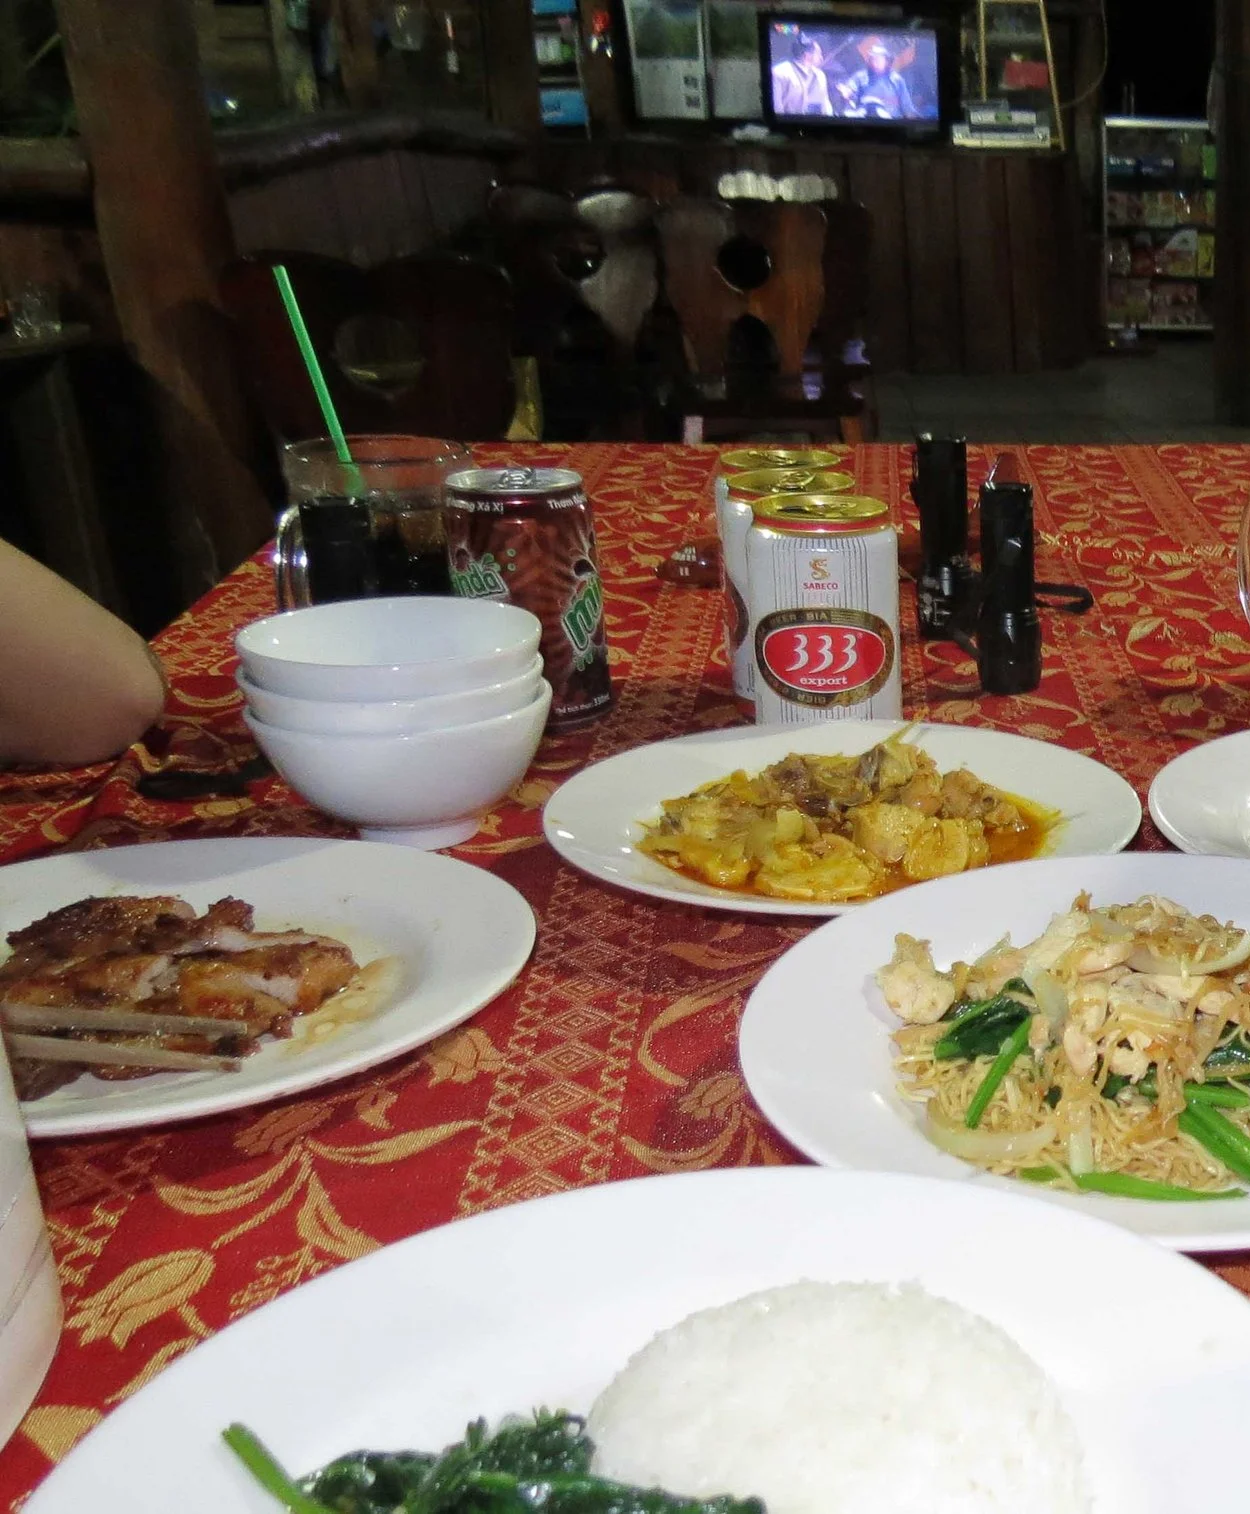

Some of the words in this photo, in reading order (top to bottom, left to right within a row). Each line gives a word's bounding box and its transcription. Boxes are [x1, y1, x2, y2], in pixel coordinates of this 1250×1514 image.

[802, 582, 839, 590] SABECO
[805, 610, 828, 621] BIA
[785, 633, 857, 674] 333
[799, 675, 848, 687] export
